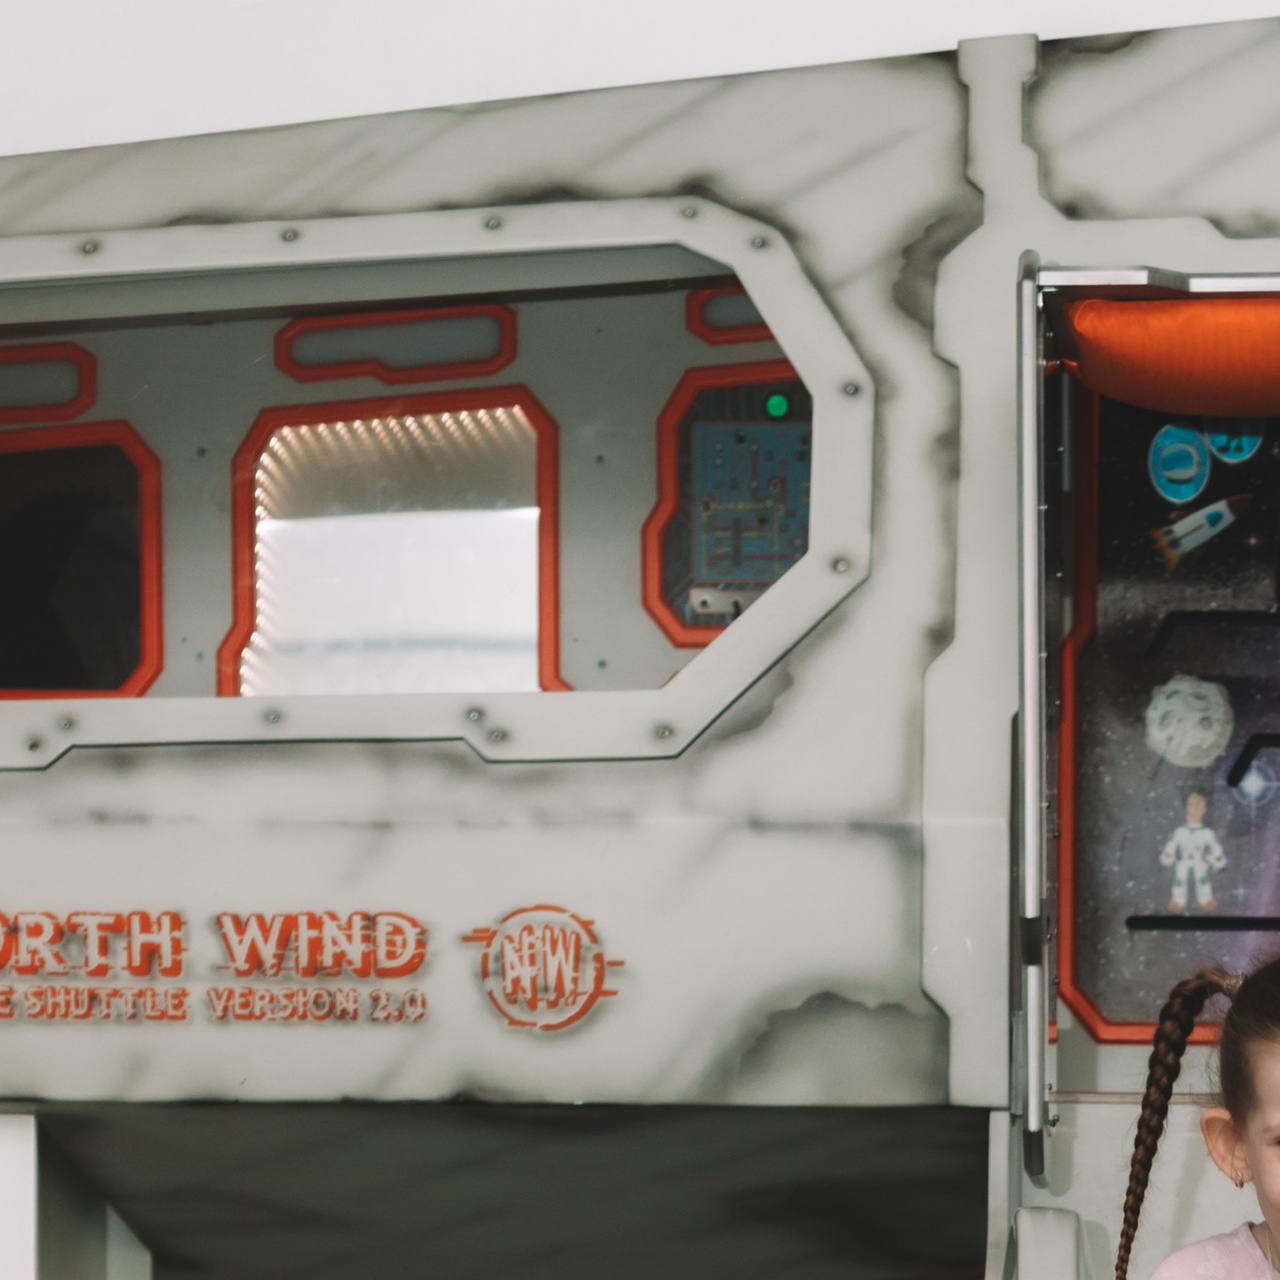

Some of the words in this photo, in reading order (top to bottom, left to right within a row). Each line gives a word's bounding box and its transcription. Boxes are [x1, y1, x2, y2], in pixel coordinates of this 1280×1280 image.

[0, 911, 187, 977] RTH
[216, 910, 427, 979] WIND
[25, 985, 188, 1020] SHUTTLE
[206, 986, 360, 1022] VERSION
